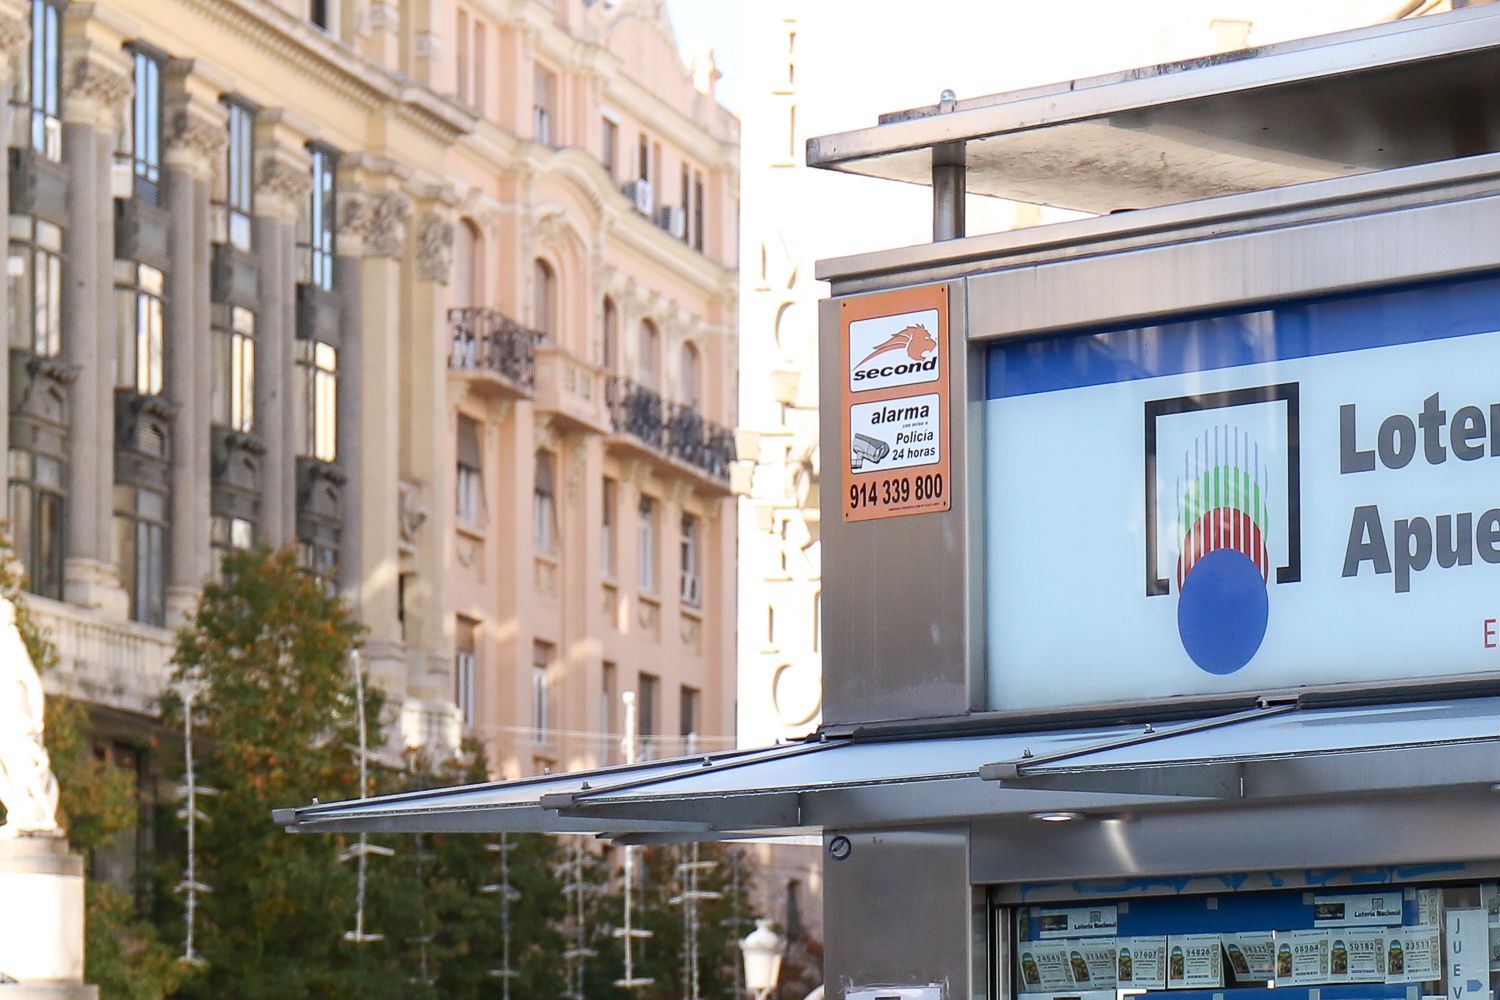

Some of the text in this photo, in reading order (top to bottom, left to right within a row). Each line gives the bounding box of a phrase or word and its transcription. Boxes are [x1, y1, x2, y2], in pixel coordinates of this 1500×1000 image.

[853, 357, 937, 381] second
[871, 405, 929, 425] alarma
[896, 428, 933, 445] Policía
[892, 446, 936, 460] 24 horas
[850, 473, 942, 508] 914 339 800
